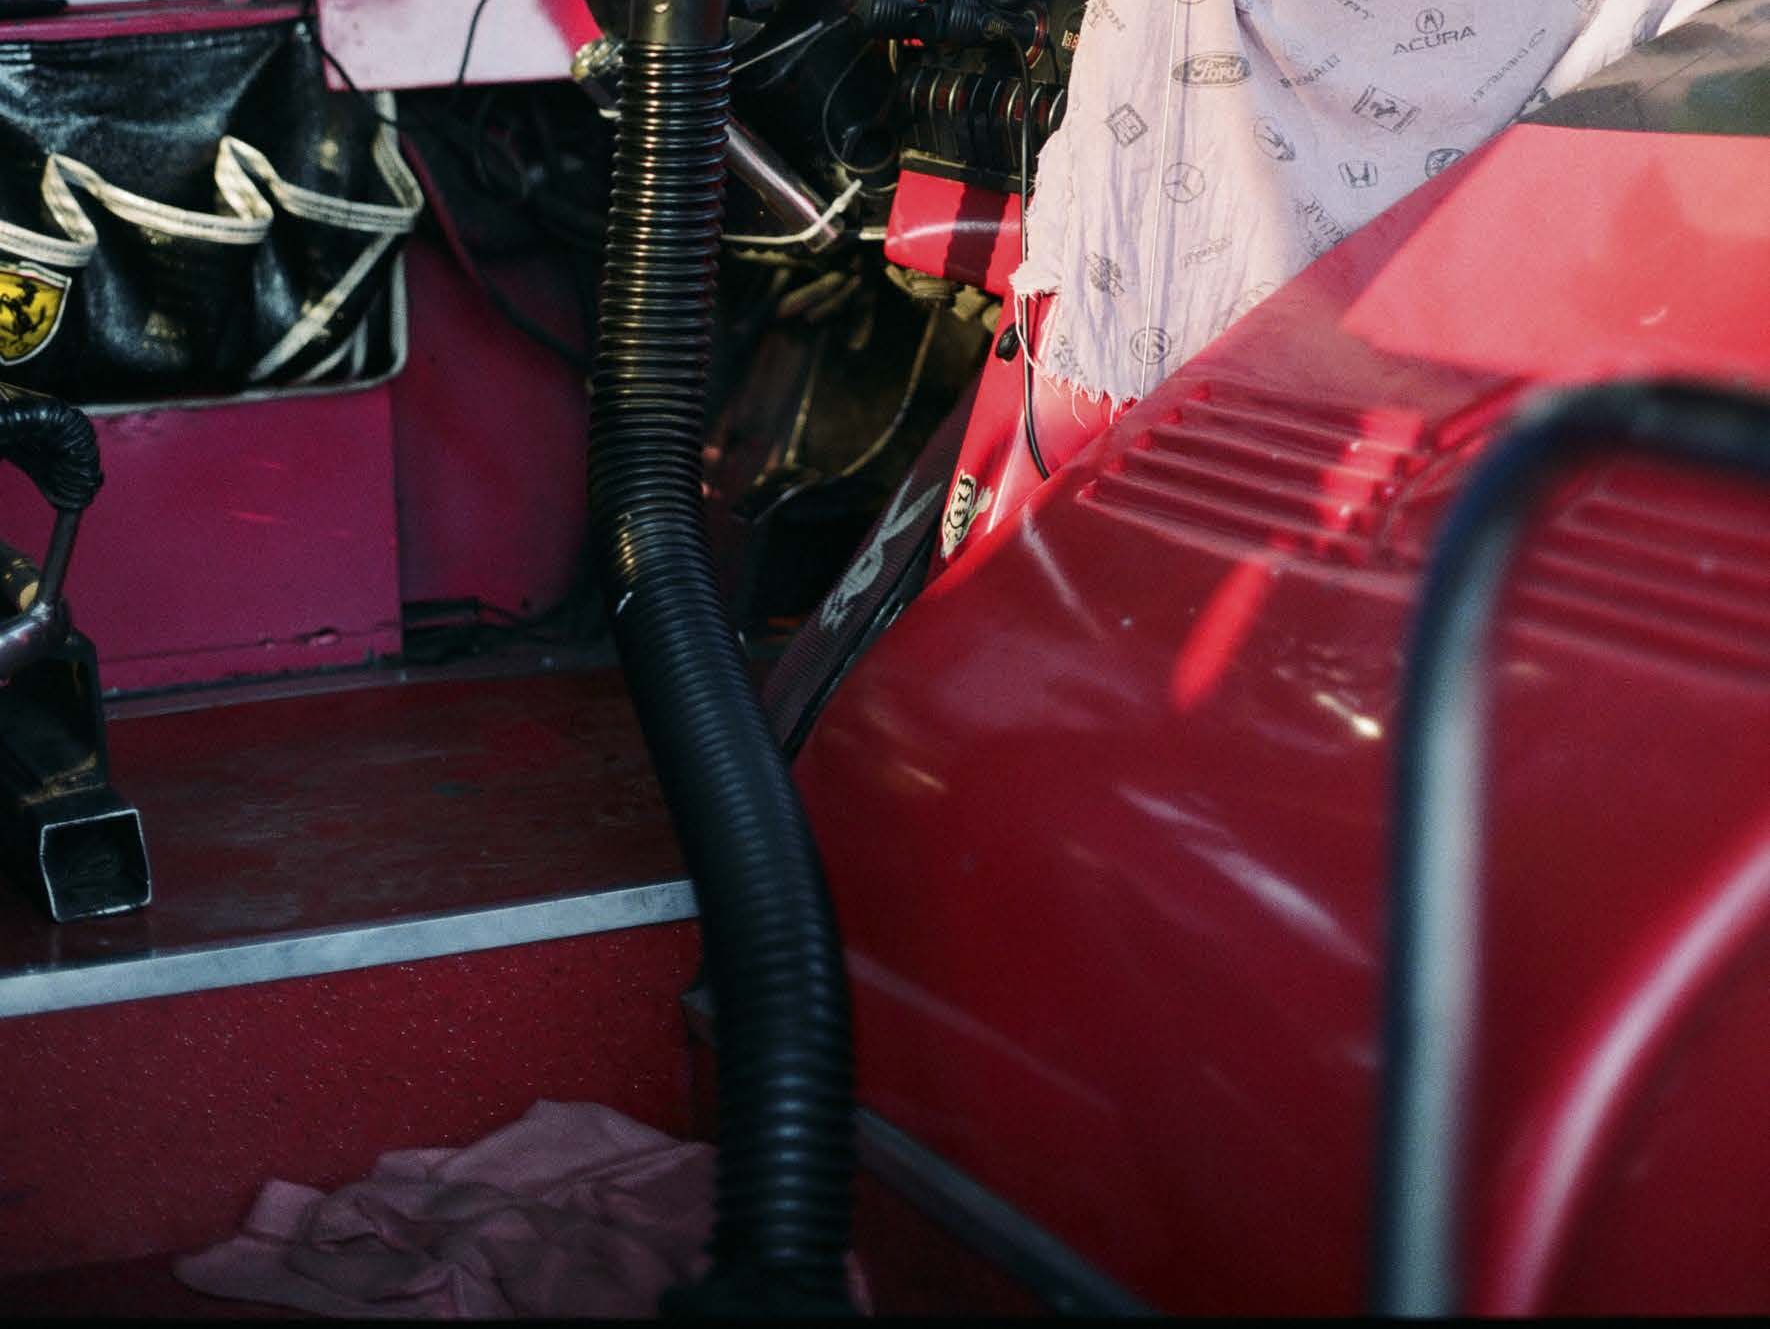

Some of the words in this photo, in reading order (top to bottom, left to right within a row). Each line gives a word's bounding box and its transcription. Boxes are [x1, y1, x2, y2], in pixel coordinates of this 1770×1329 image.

[1393, 26, 1477, 55] ACURA
[1190, 56, 1243, 81] Ford
[1303, 199, 1344, 244] GUAR
